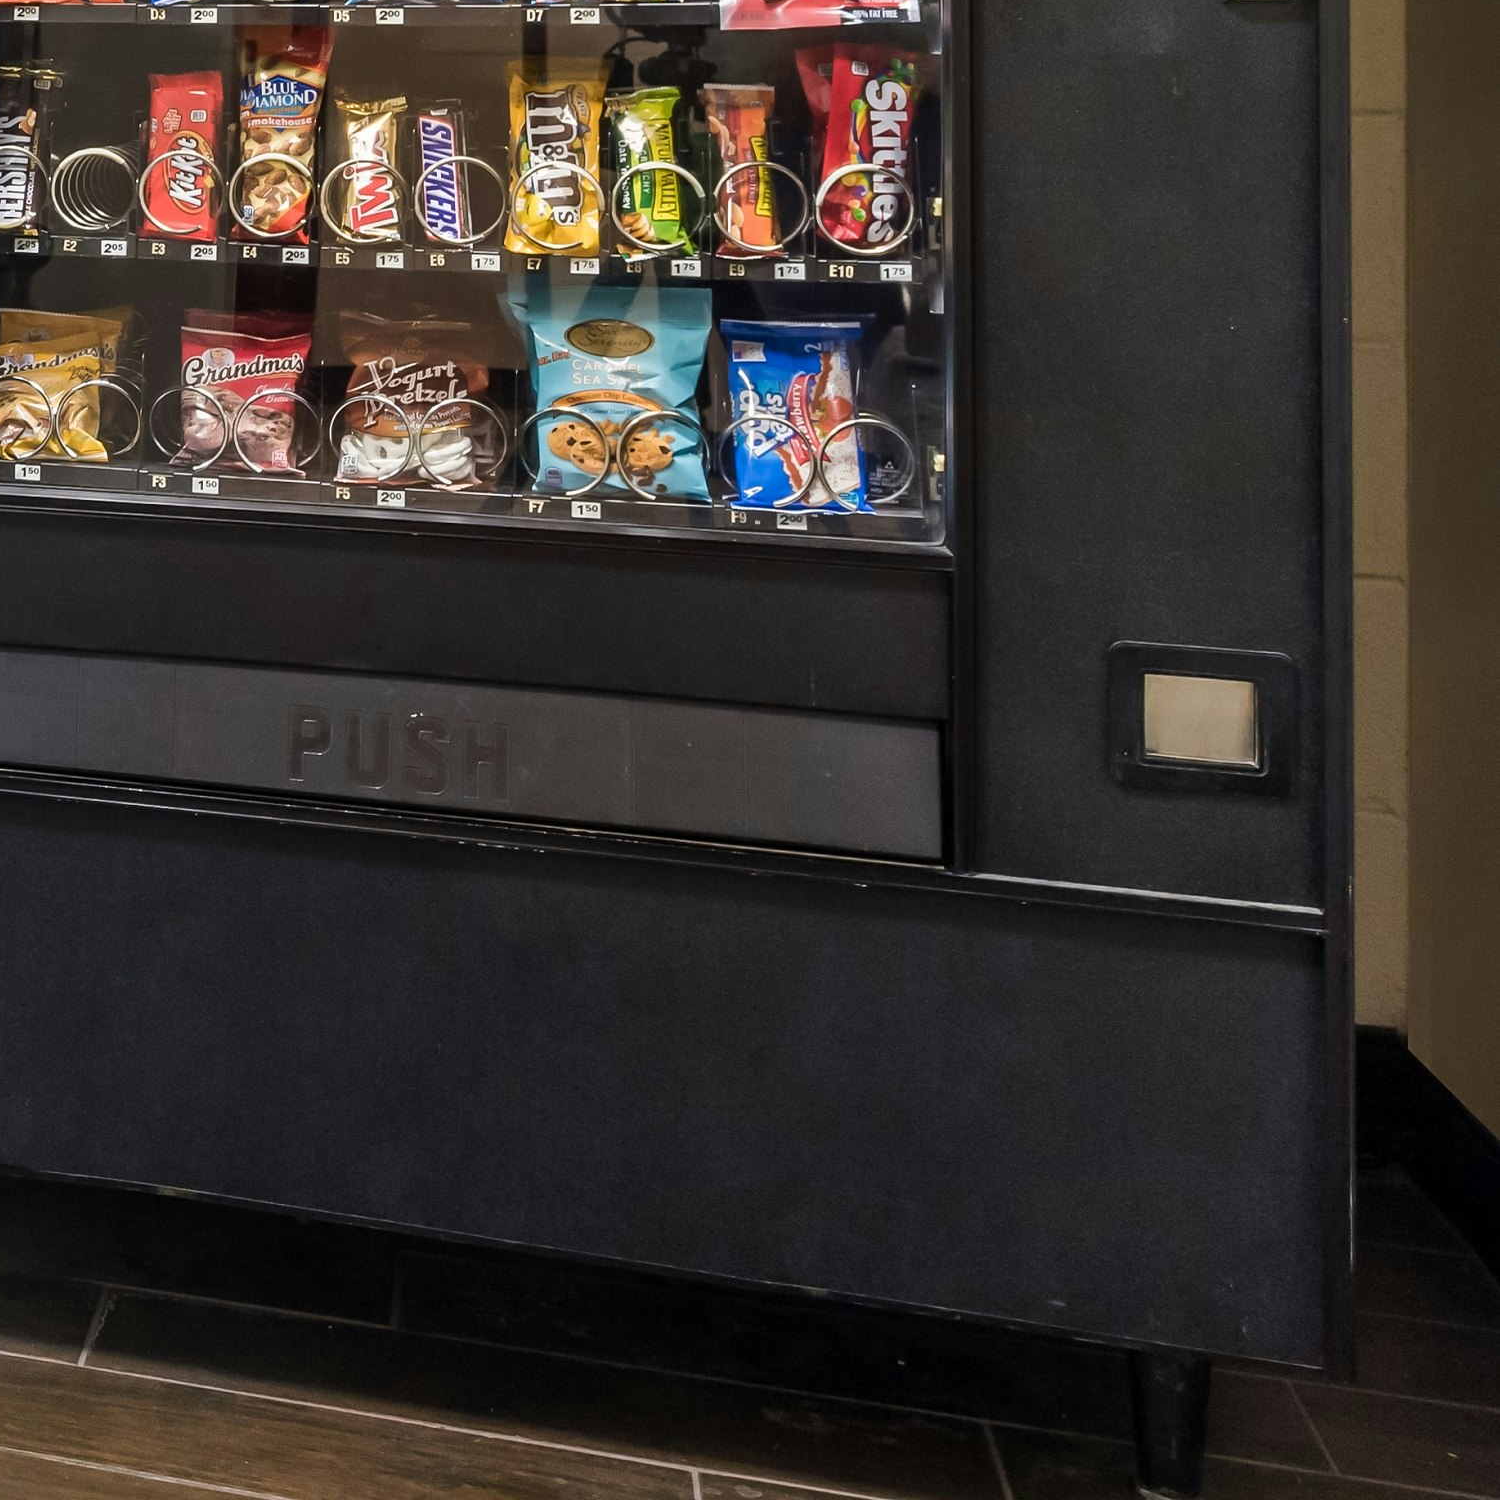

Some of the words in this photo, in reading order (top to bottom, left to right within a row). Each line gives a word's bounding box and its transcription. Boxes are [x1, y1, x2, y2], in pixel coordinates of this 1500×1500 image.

[150, 9, 166, 20] D3
[334, 11, 350, 22] D5
[527, 10, 543, 22] D7
[261, 80, 298, 97] BLUE
[865, 80, 910, 243] Skittles
[655, 174, 680, 220] VALLEY
[152, 243, 166, 254] E3
[336, 253, 350, 265] E5
[829, 265, 854, 277] E10
[182, 354, 304, 386] Grandma's
[572, 372, 602, 386] SEA
[288, 704, 511, 802] PUSH
